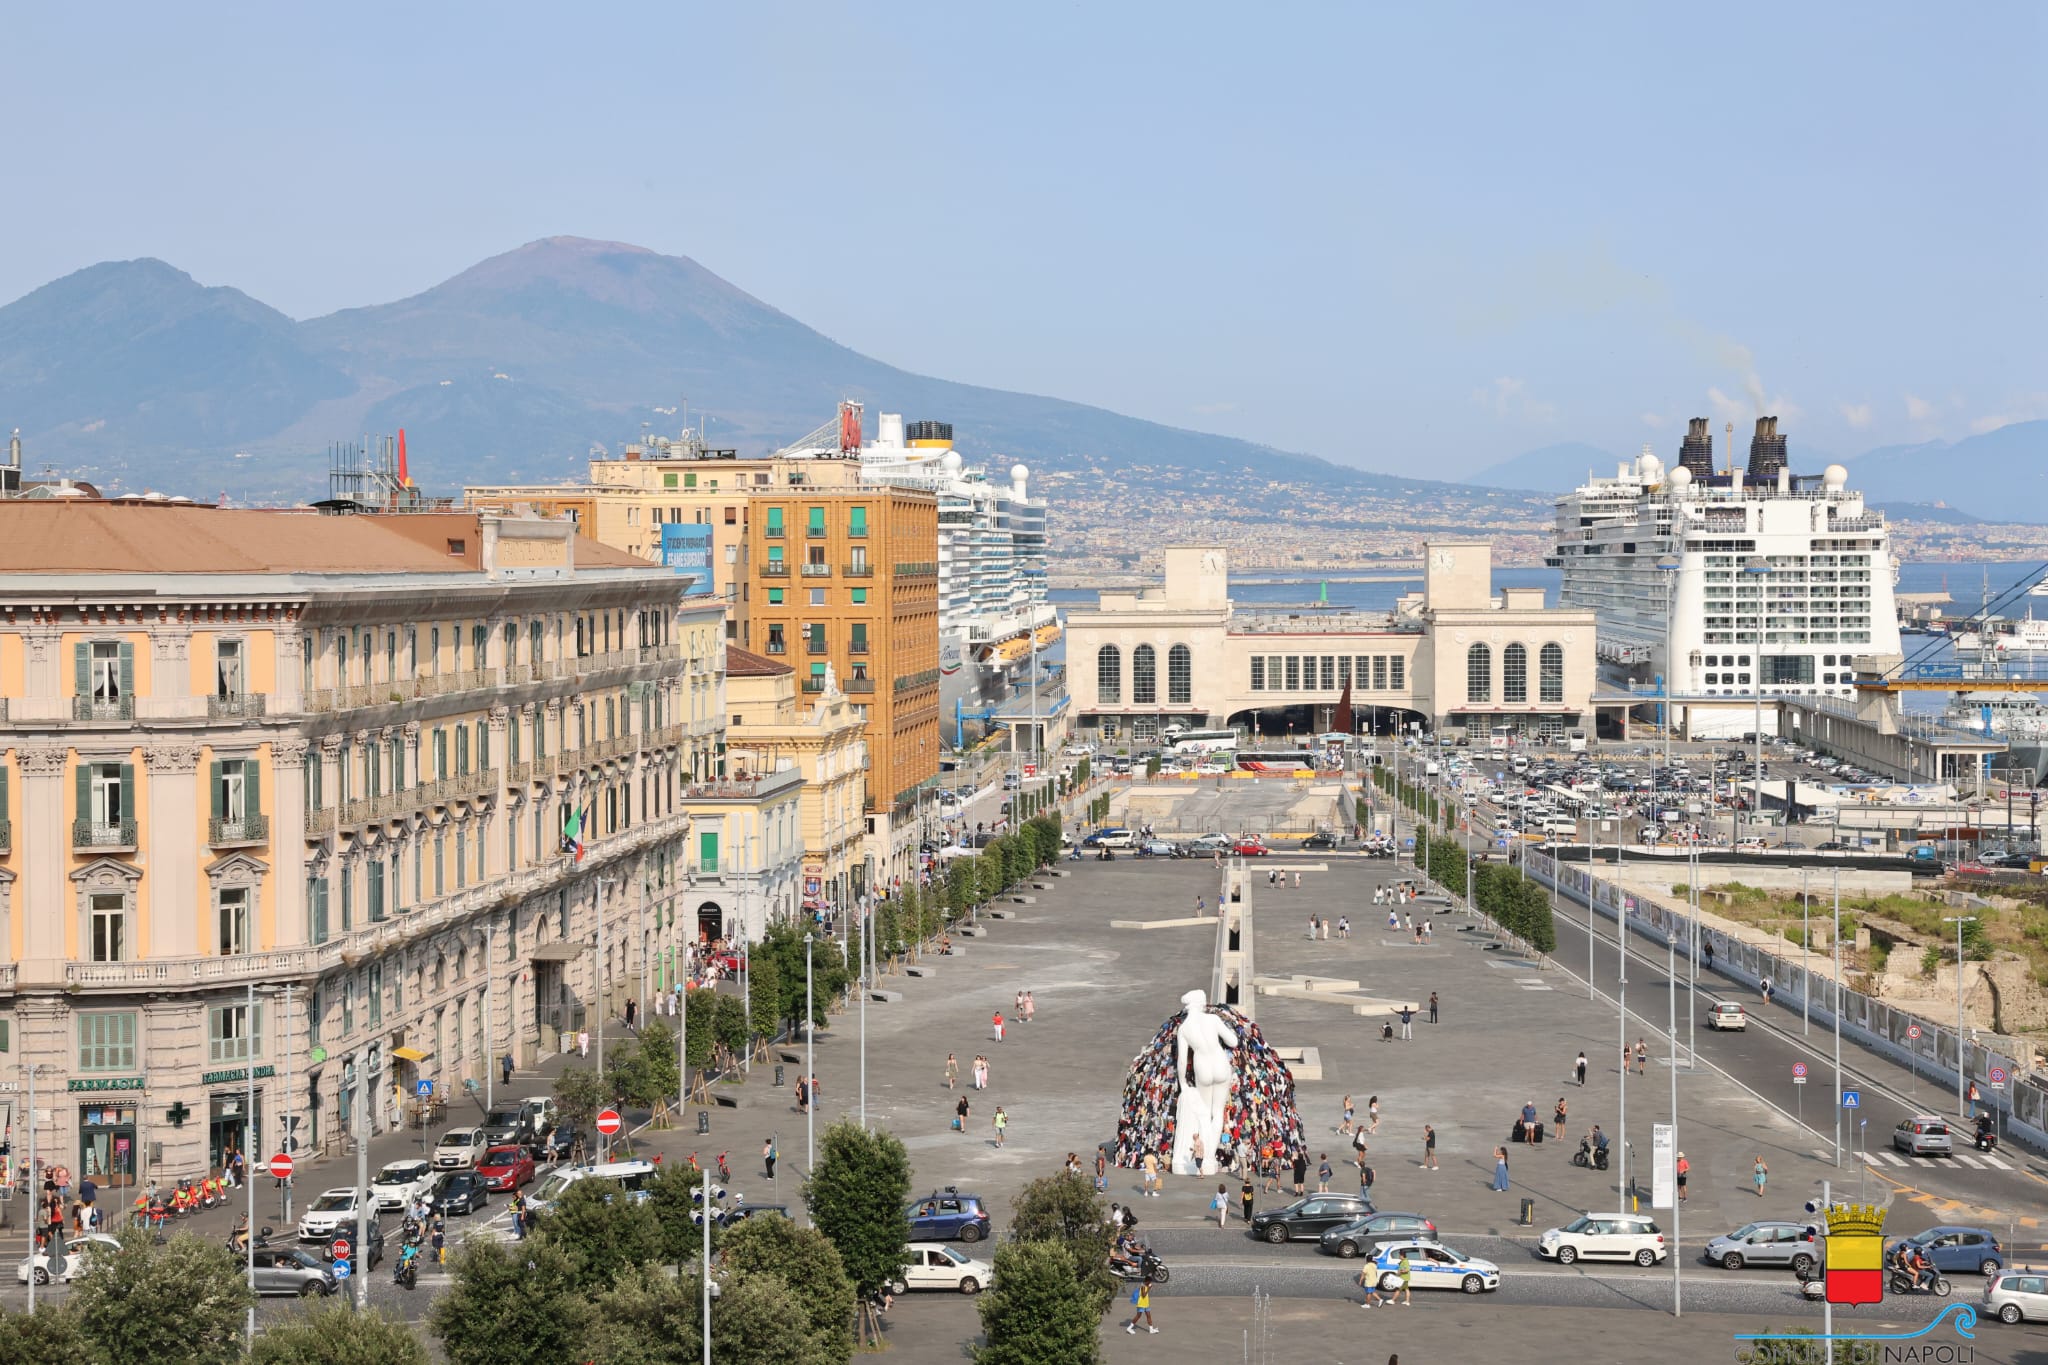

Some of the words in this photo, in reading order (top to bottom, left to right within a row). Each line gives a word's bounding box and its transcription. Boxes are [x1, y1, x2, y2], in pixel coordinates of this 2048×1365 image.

[202, 1070, 246, 1084] FARMACIA
[245, 1065, 276, 1080] LNDRA
[68, 1079, 145, 1091] FARMACIA
[333, 1246, 349, 1254] STOP
